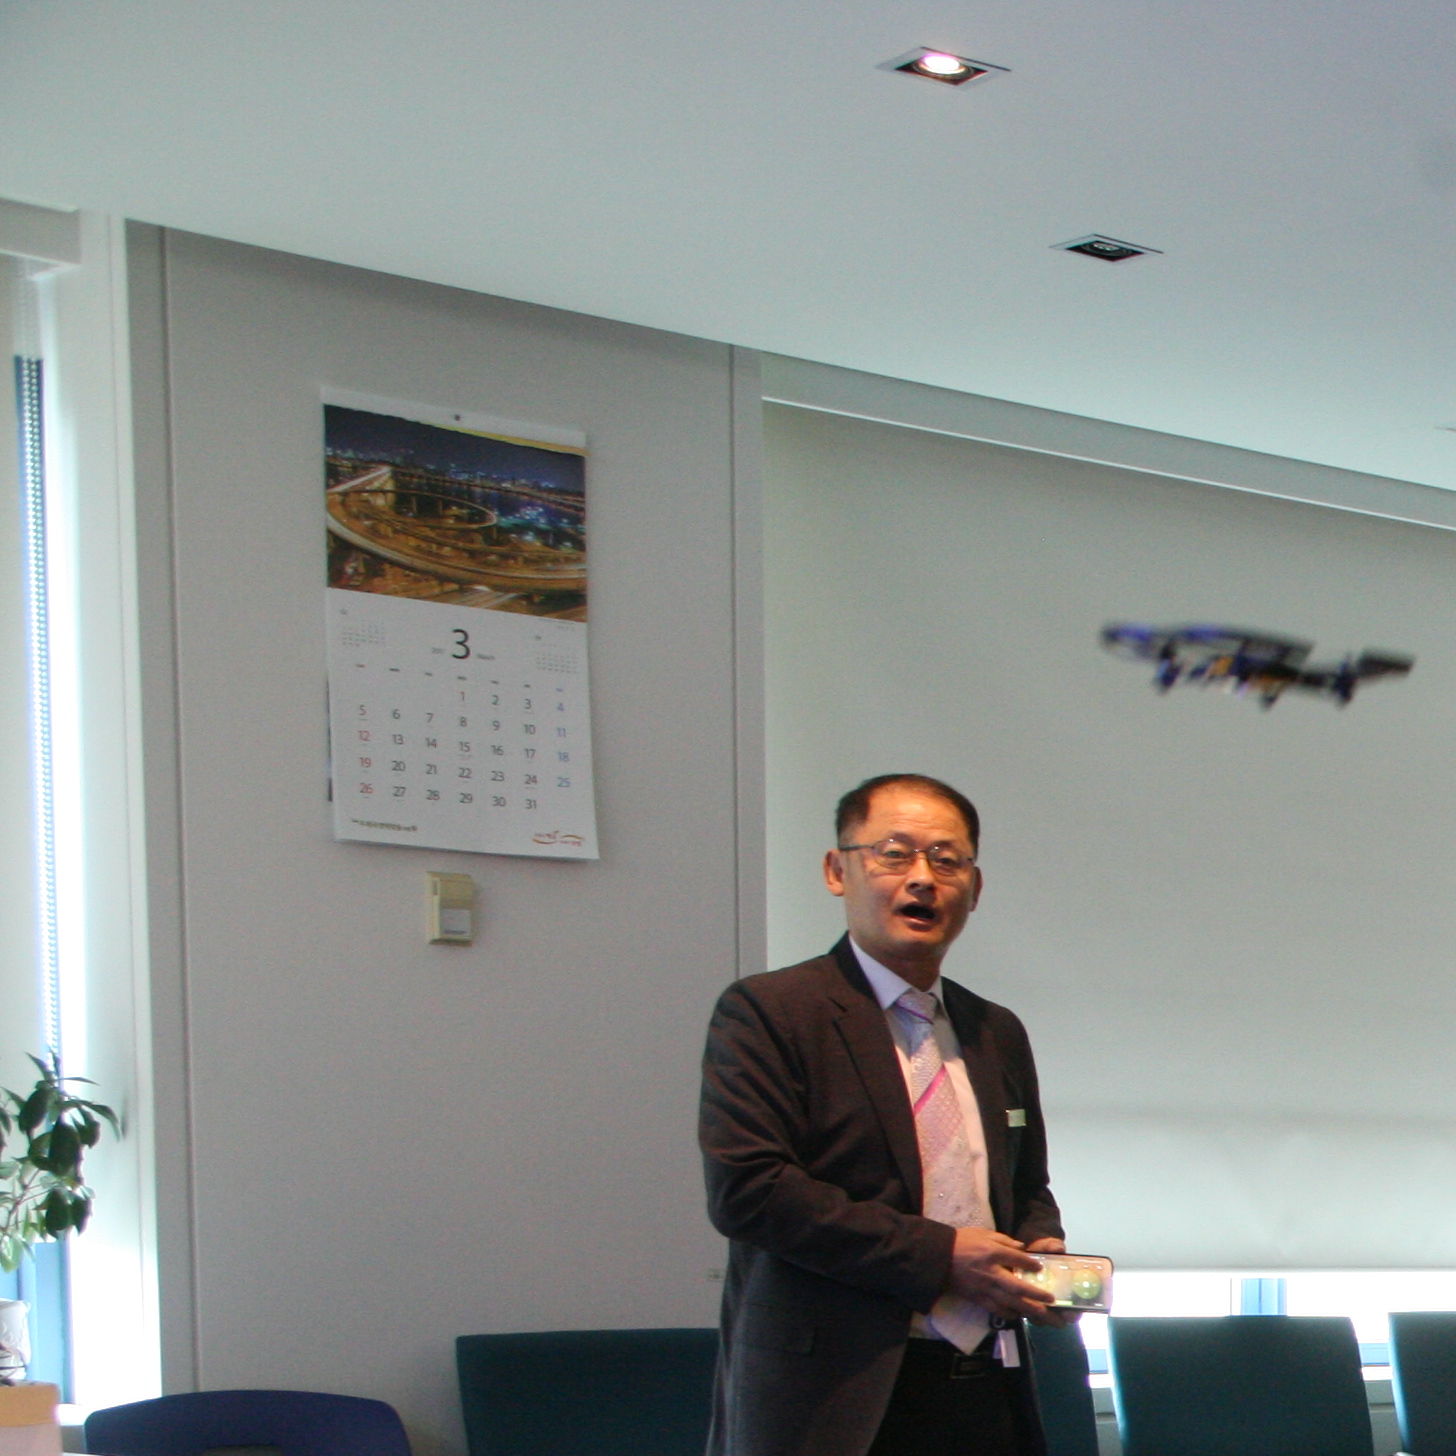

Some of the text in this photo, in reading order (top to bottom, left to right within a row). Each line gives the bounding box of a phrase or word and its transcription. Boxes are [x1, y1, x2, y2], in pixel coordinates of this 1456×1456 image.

[452, 628, 471, 660] 3
[460, 691, 564, 711] 1 2 3 4
[359, 705, 567, 738] 5 6 7 8 9 10 11
[358, 731, 569, 762] 12 13 14 15 16 17 18
[360, 757, 570, 787] 19 20 21 22 23 24 25
[360, 783, 536, 809] 26 27 28 29 30 31
